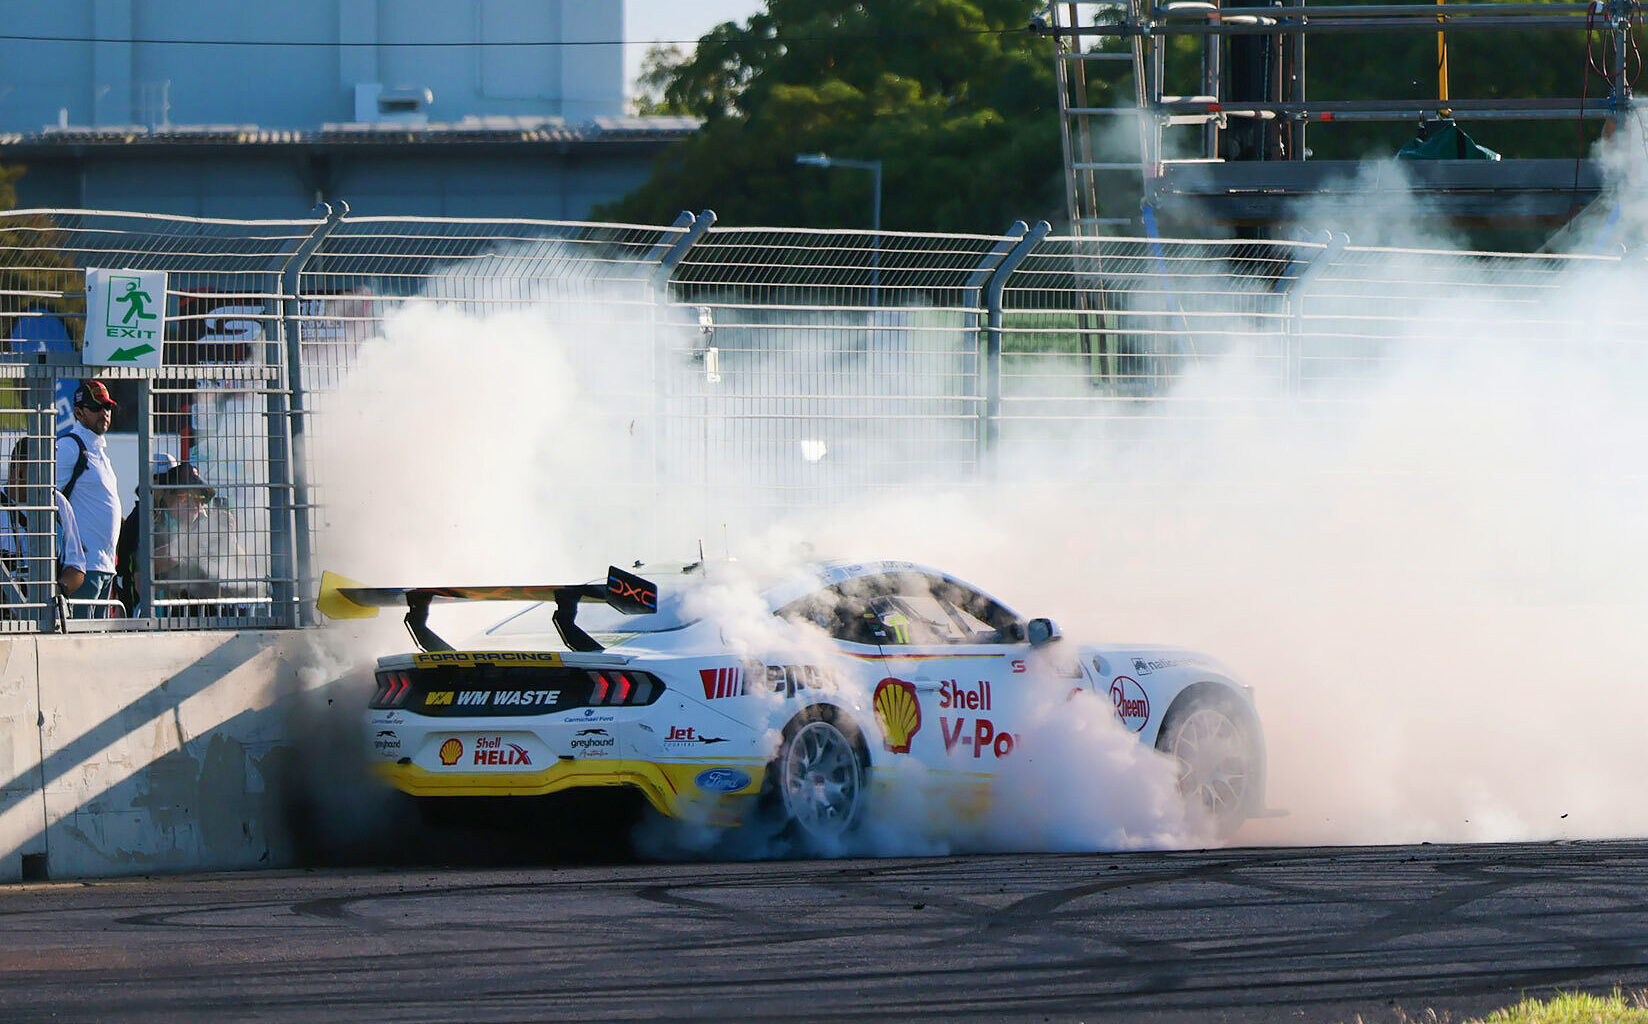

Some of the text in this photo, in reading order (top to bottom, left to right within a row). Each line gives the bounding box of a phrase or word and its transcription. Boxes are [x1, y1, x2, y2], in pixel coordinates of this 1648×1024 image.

[106, 328, 156, 339] EXIT
[418, 652, 552, 662] FORD RACING
[457, 691, 490, 705] WM
[493, 690, 561, 705] WASTE
[939, 679, 991, 711] Shell
[1112, 679, 1147, 725] Rheem
[664, 726, 695, 740] Jet
[476, 737, 501, 749] Shell
[571, 737, 615, 749] greyhound
[474, 744, 532, 765] HELIX
